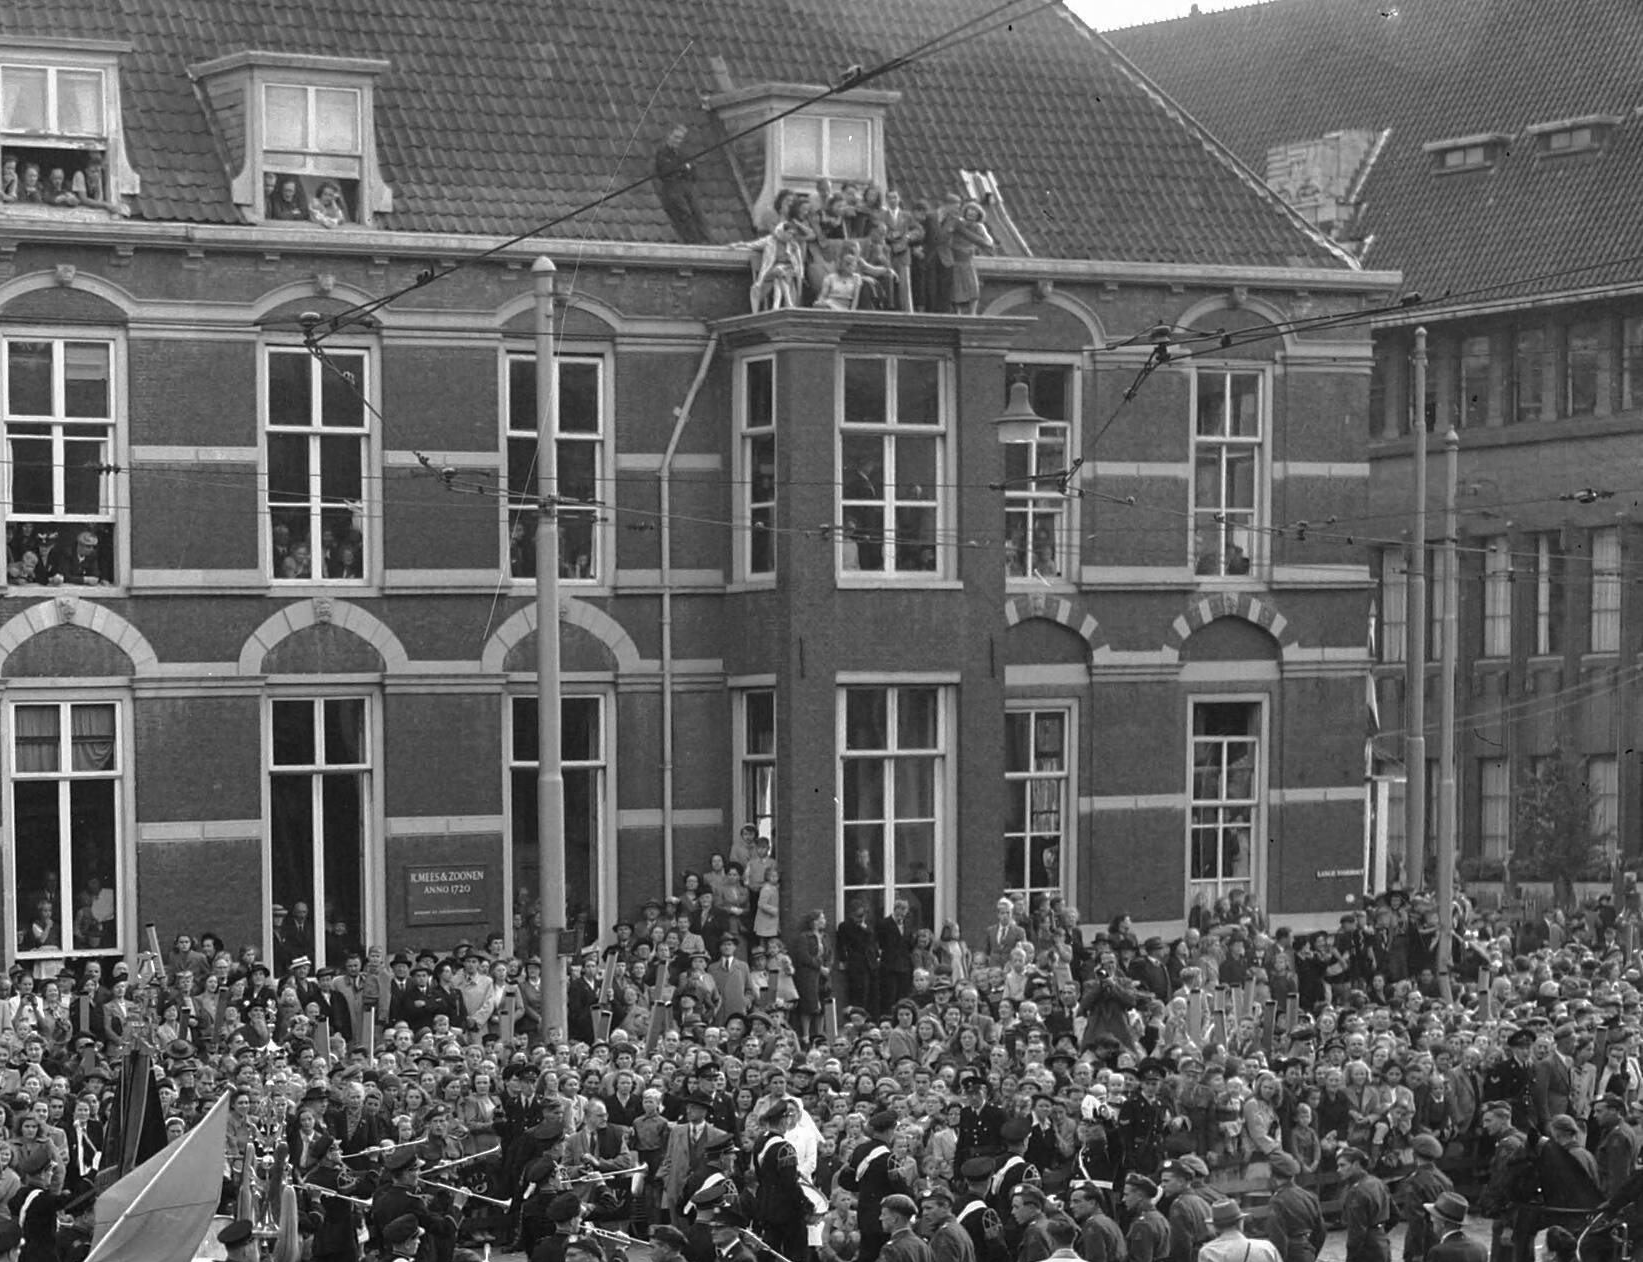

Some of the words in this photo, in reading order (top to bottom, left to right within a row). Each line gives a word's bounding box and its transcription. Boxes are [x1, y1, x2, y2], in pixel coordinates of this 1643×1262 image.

[448, 870, 485, 881] ZOONEN
[423, 885, 450, 895] ANNO
[450, 884, 472, 895] 1720
